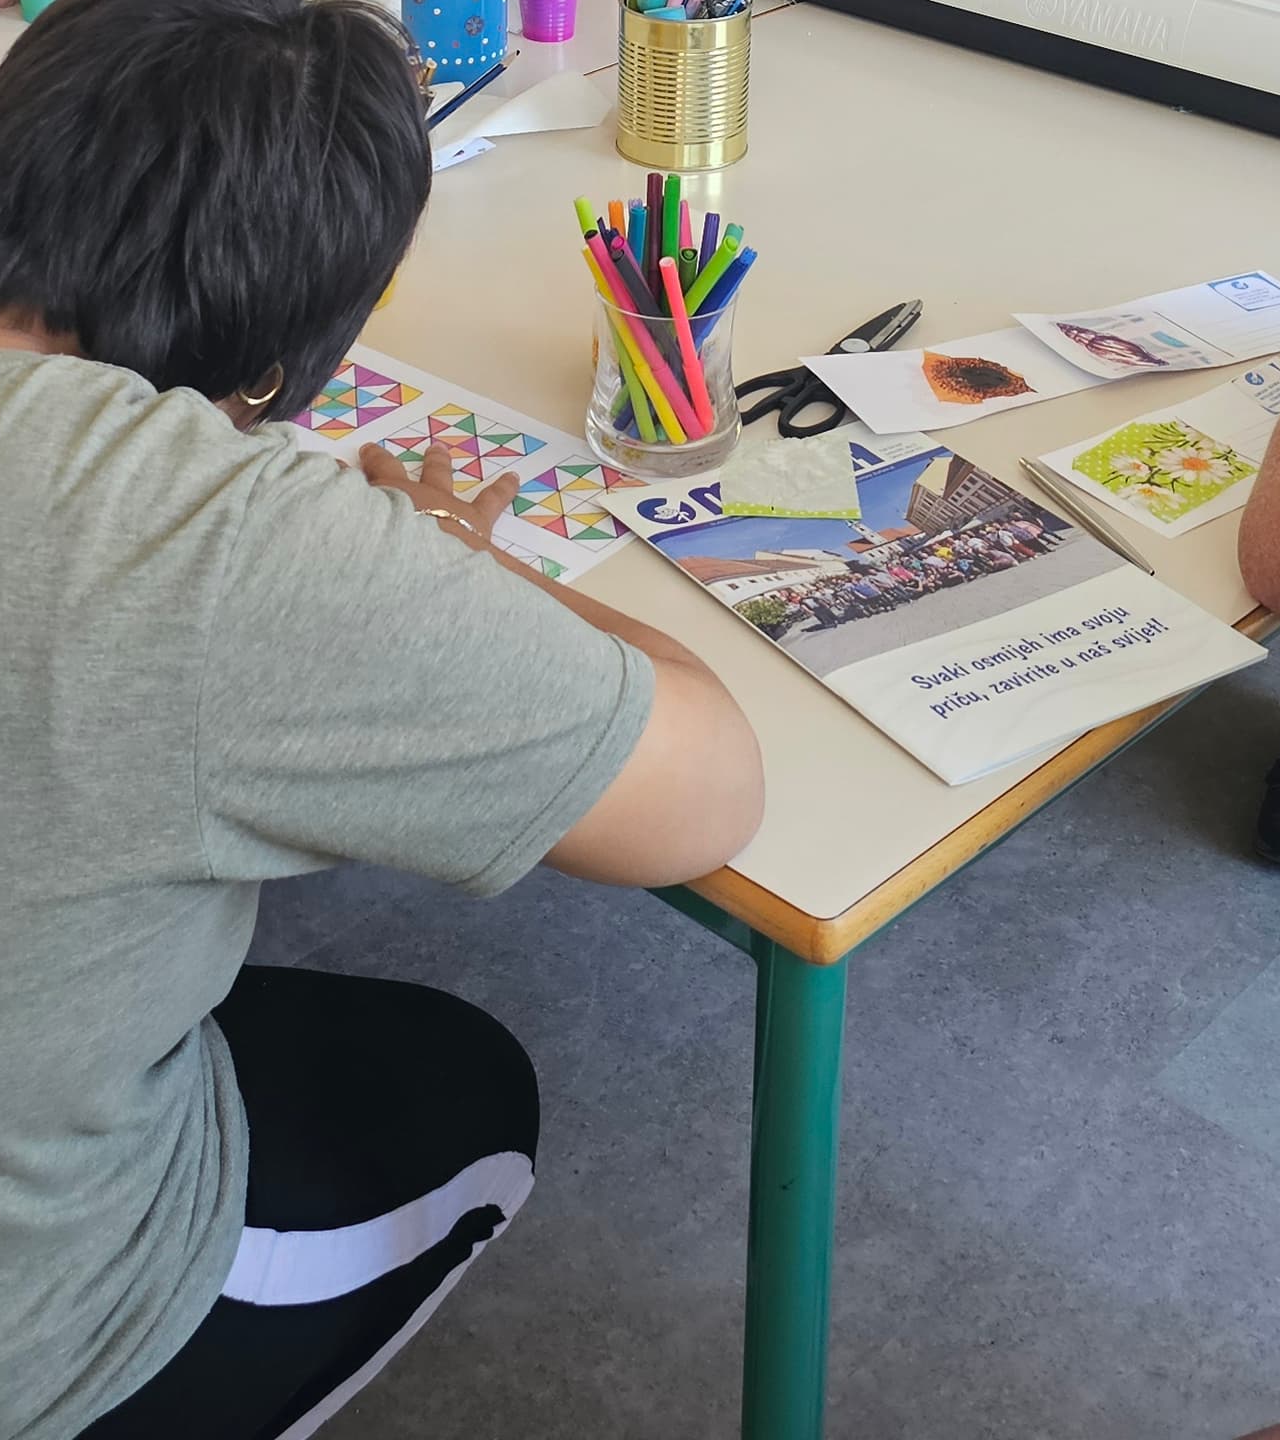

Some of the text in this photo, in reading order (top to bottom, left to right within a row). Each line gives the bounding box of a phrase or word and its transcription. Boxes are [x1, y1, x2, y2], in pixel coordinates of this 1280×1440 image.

[910, 606, 1131, 690] Svaki osmijeh ima svoju
[929, 617, 1169, 719] priču, zavirite u naš svijet!
